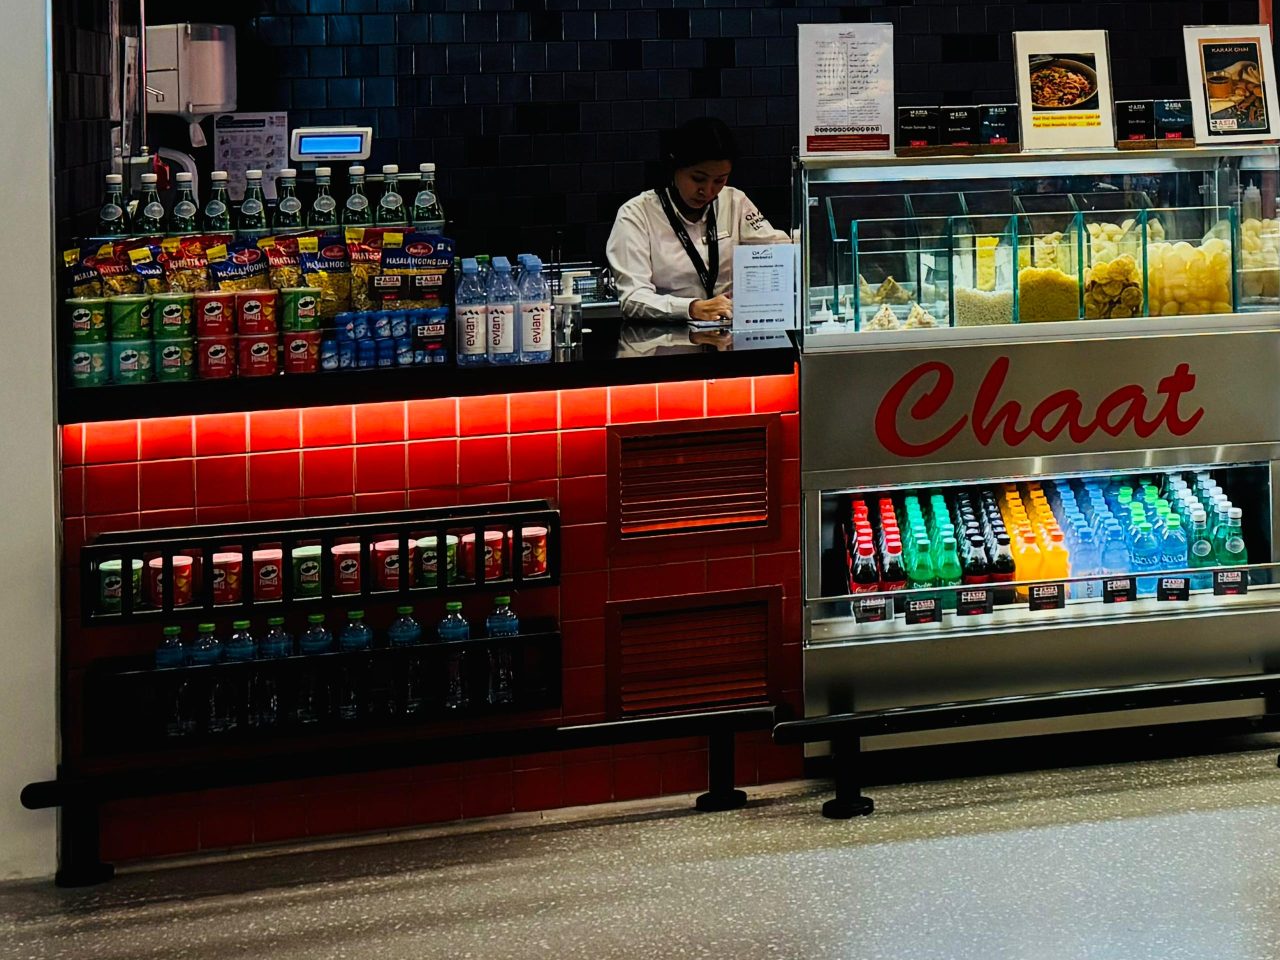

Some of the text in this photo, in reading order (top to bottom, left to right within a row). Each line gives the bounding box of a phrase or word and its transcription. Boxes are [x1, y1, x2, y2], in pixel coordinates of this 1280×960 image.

[466, 316, 475, 347] evian
[492, 316, 501, 346] evian
[532, 313, 542, 344] evian
[874, 356, 1205, 458] Chaat
